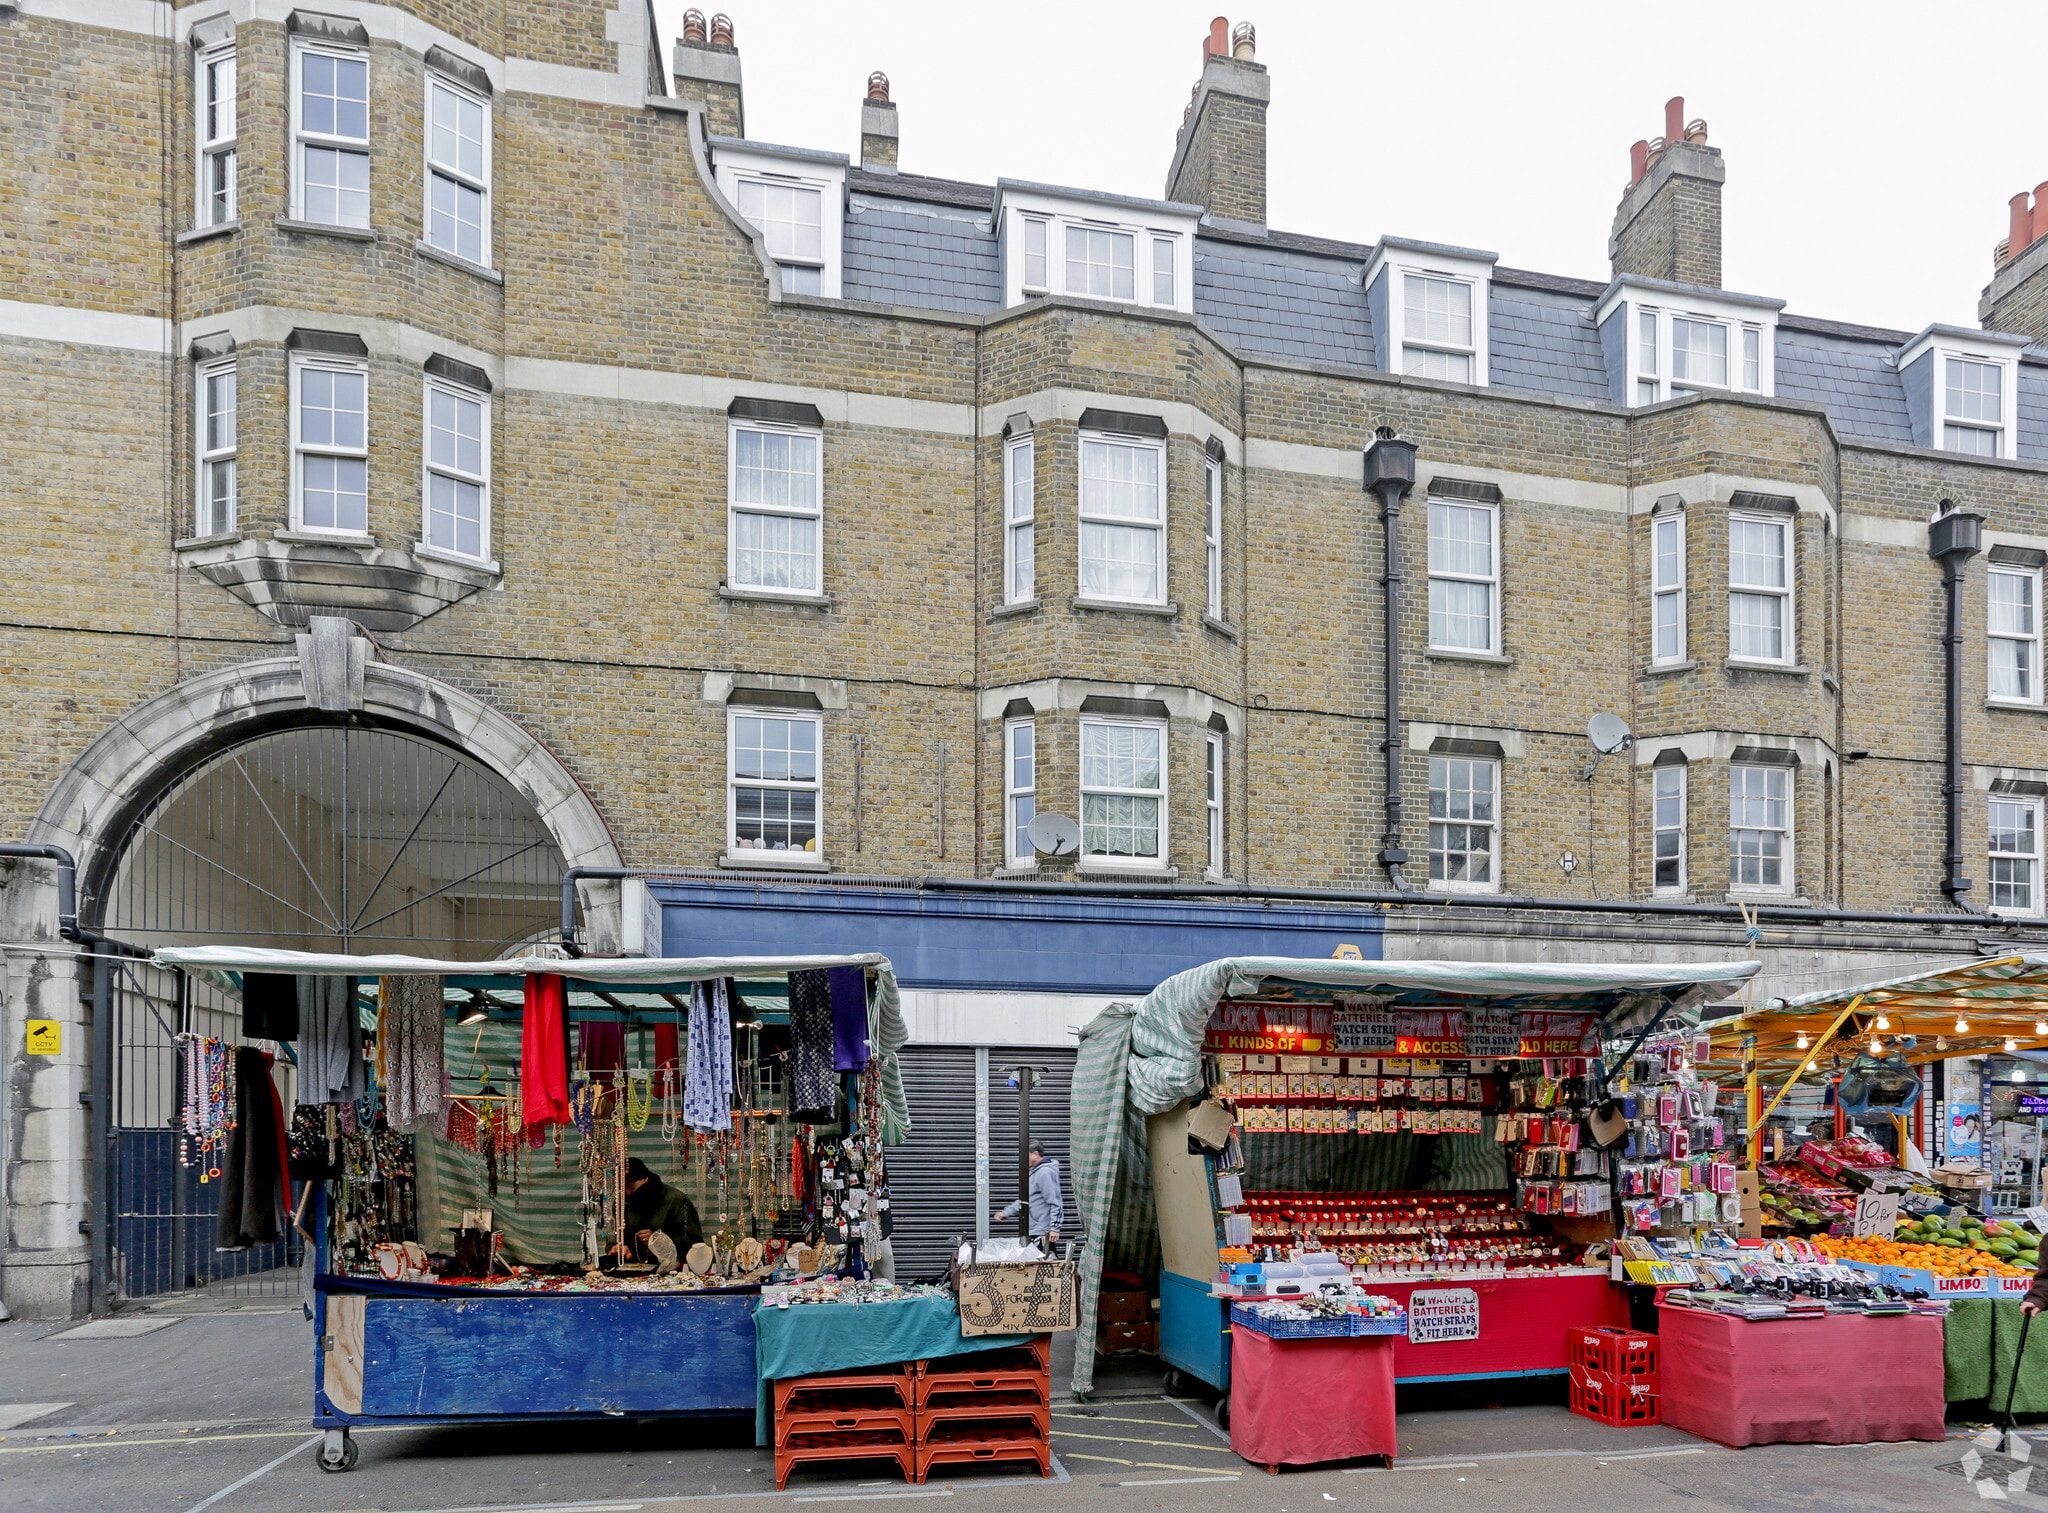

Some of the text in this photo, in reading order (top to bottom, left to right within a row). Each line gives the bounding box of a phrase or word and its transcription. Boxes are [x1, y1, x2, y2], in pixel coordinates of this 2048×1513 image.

[1347, 1003, 1383, 1011] WATCH
[1204, 1005, 1260, 1032] NLOCK
[1263, 1006, 1308, 1033] YOUR
[1333, 1013, 1388, 1022] BATTERIES
[1475, 1014, 1508, 1023] WATCH
[1334, 1024, 1368, 1034] WATCH
[1463, 1025, 1512, 1034] BATTERIES
[1545, 1015, 1585, 1036] HERE
[1228, 1035, 1274, 1050] KINDS
[1278, 1037, 1296, 1050] OF
[1344, 1036, 1388, 1045] FIT HERE
[1492, 1036, 1519, 1045] STRAP
[1398, 1040, 1466, 1054] & ACCESS
[1475, 1046, 1511, 1055] FIT HERE
[1520, 1041, 1577, 1053] OLD HERE
[1939, 1278, 2034, 1291] LIMBO LIM
[961, 1263, 1073, 1329] 3 FOR £1
[1428, 1296, 1461, 1305] WATCH
[1414, 1304, 1475, 1316] BATTERIES &
[1414, 1314, 1476, 1328] WATCH STRAPS
[1002, 1323, 1021, 1331] MIX
[1427, 1327, 1464, 1338] FIT HERE
